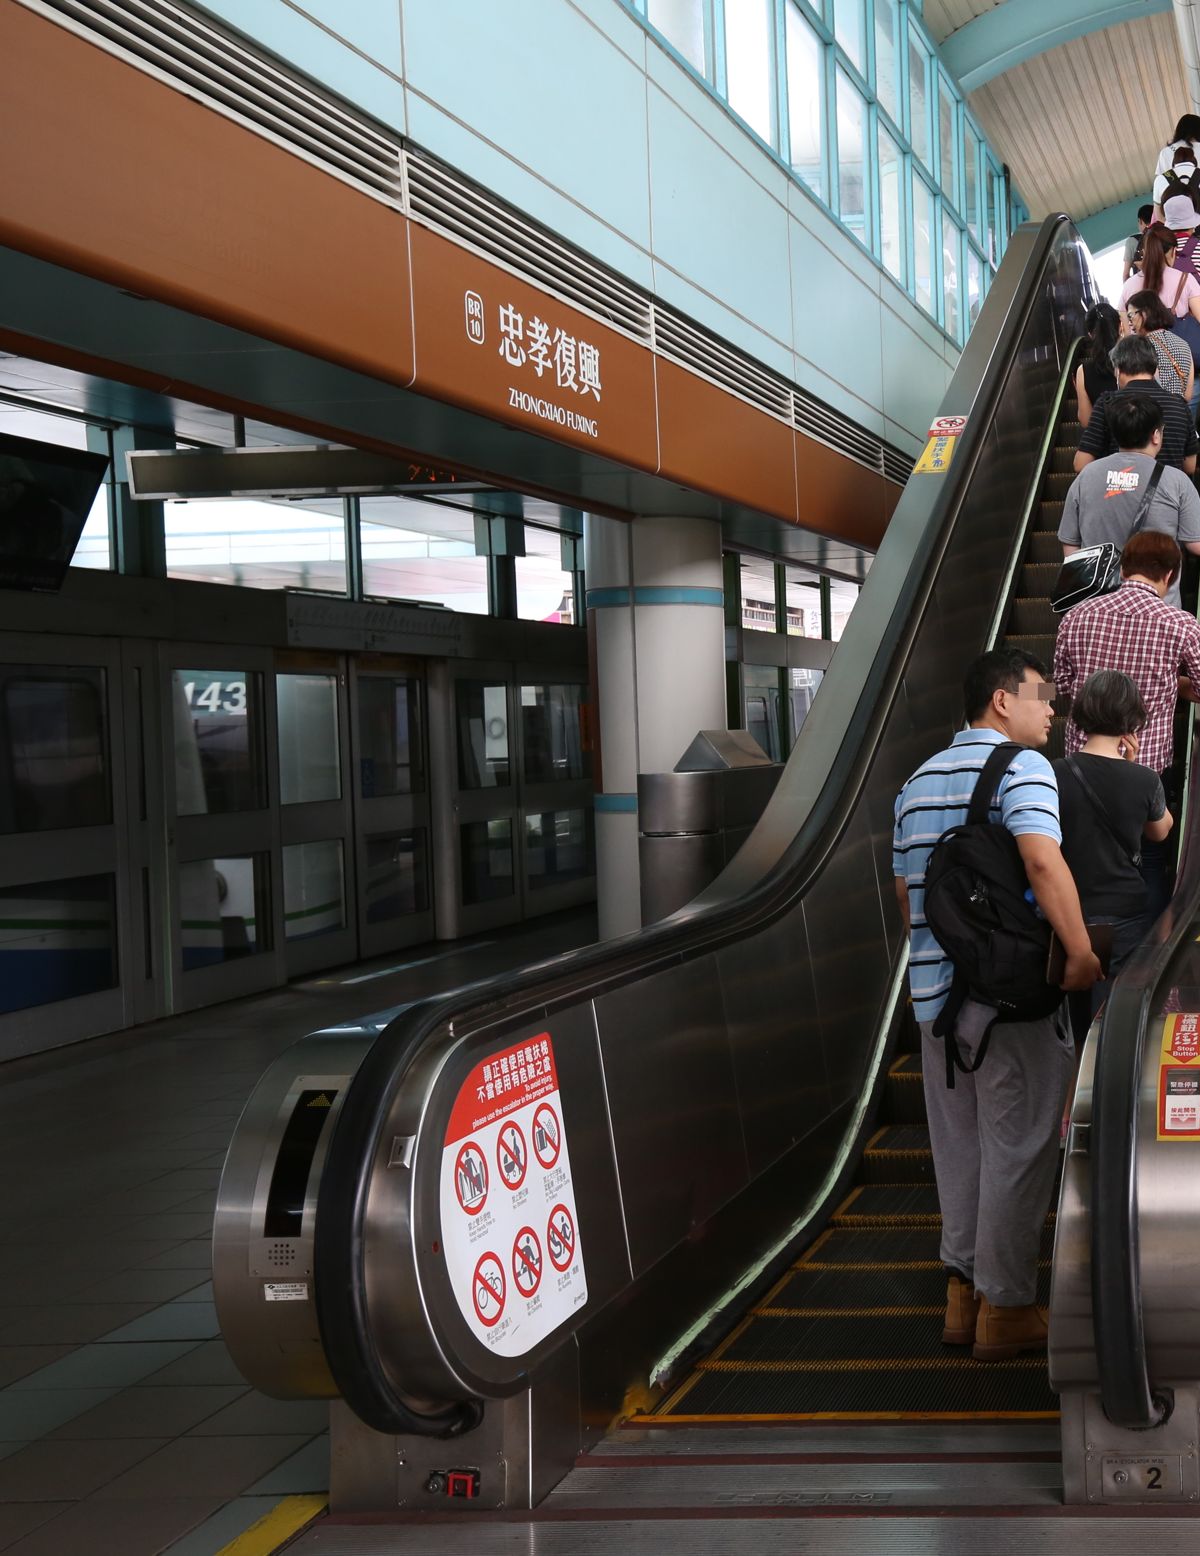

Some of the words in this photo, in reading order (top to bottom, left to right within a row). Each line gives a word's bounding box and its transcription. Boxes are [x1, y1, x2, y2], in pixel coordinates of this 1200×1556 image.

[468, 297, 482, 319] BR
[469, 319, 481, 337] 10
[498, 303, 602, 402] 忠孝復興
[508, 387, 566, 426] ZHONGXIAO
[566, 410, 599, 438] FUXING
[1106, 470, 1140, 487] PACKER
[1177, 1045, 1195, 1053] Stop
[1146, 1467, 1162, 1489] 2
